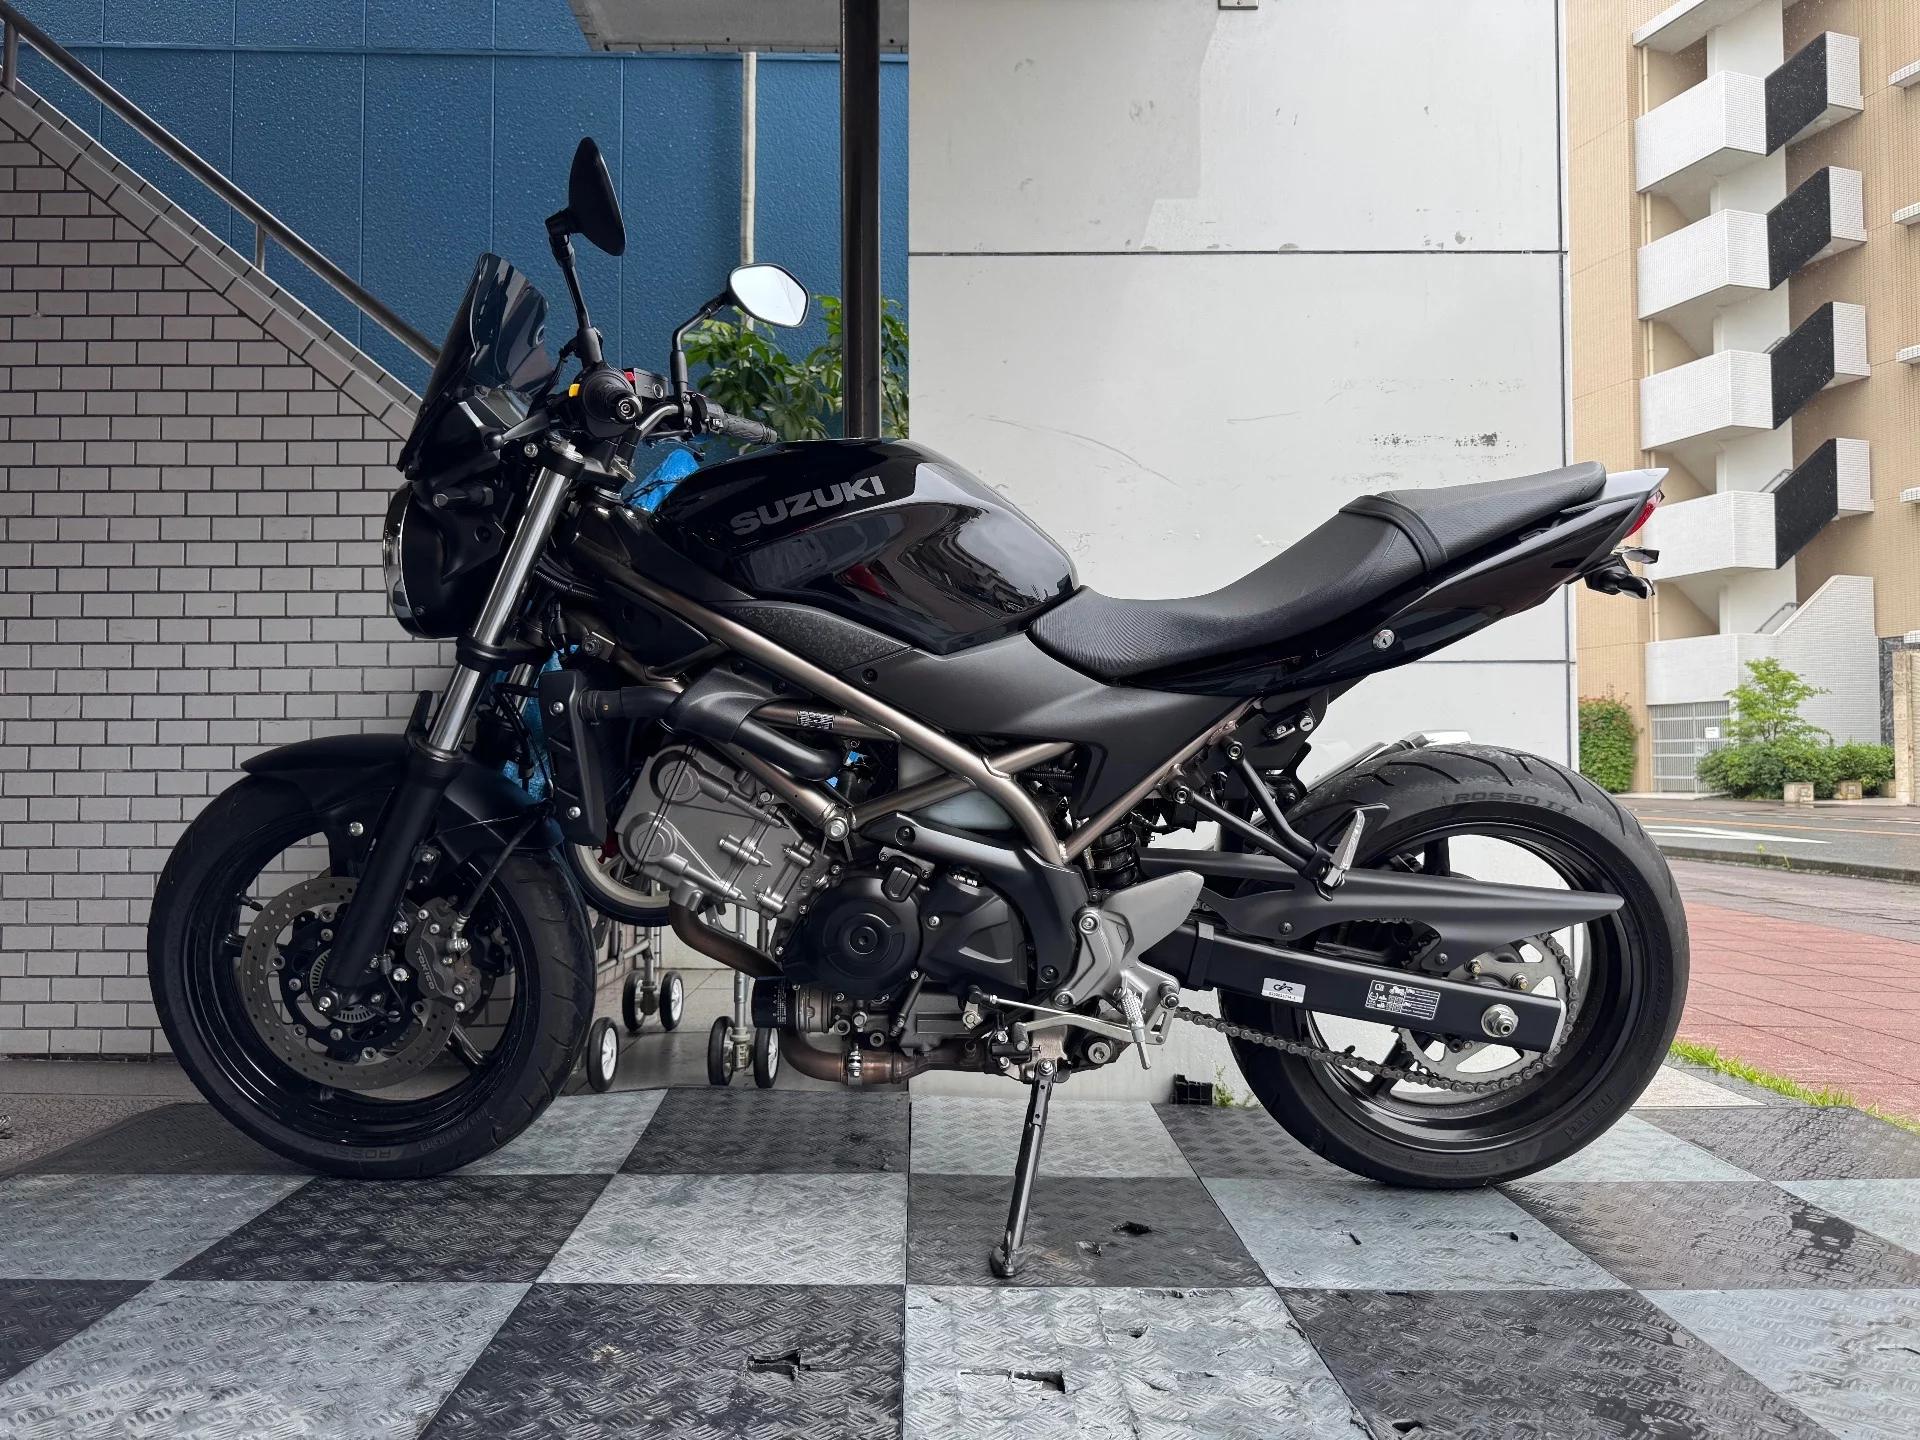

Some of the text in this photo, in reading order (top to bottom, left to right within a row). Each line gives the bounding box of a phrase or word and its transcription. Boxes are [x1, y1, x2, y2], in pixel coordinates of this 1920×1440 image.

[730, 475, 886, 536] SUZUKI
[1454, 791, 1539, 805] ROSSO
[415, 947, 435, 990] TOKICO
[323, 1146, 392, 1159] ROSSO
